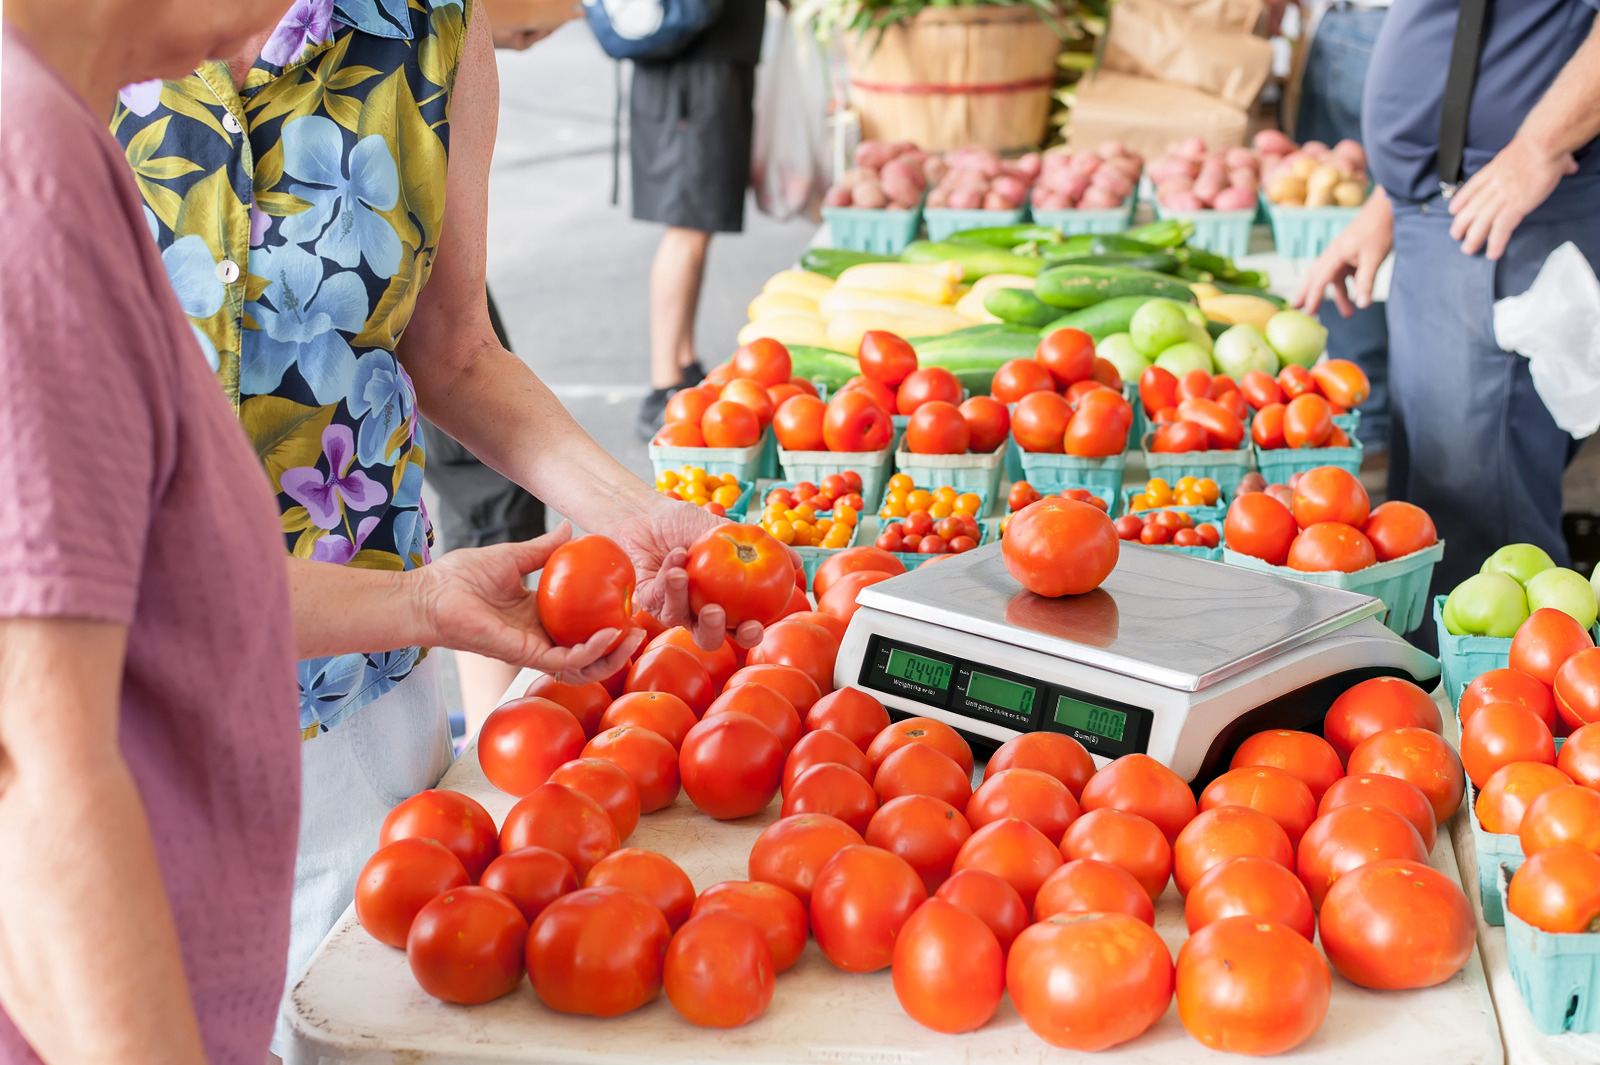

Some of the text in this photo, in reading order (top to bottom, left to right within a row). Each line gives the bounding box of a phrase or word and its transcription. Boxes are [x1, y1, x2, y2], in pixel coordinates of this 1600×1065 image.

[893, 678, 913, 690] Weight
[965, 700, 978, 709] Unit
[978, 703, 993, 713] price
[1073, 730, 1099, 745] Sum($)
